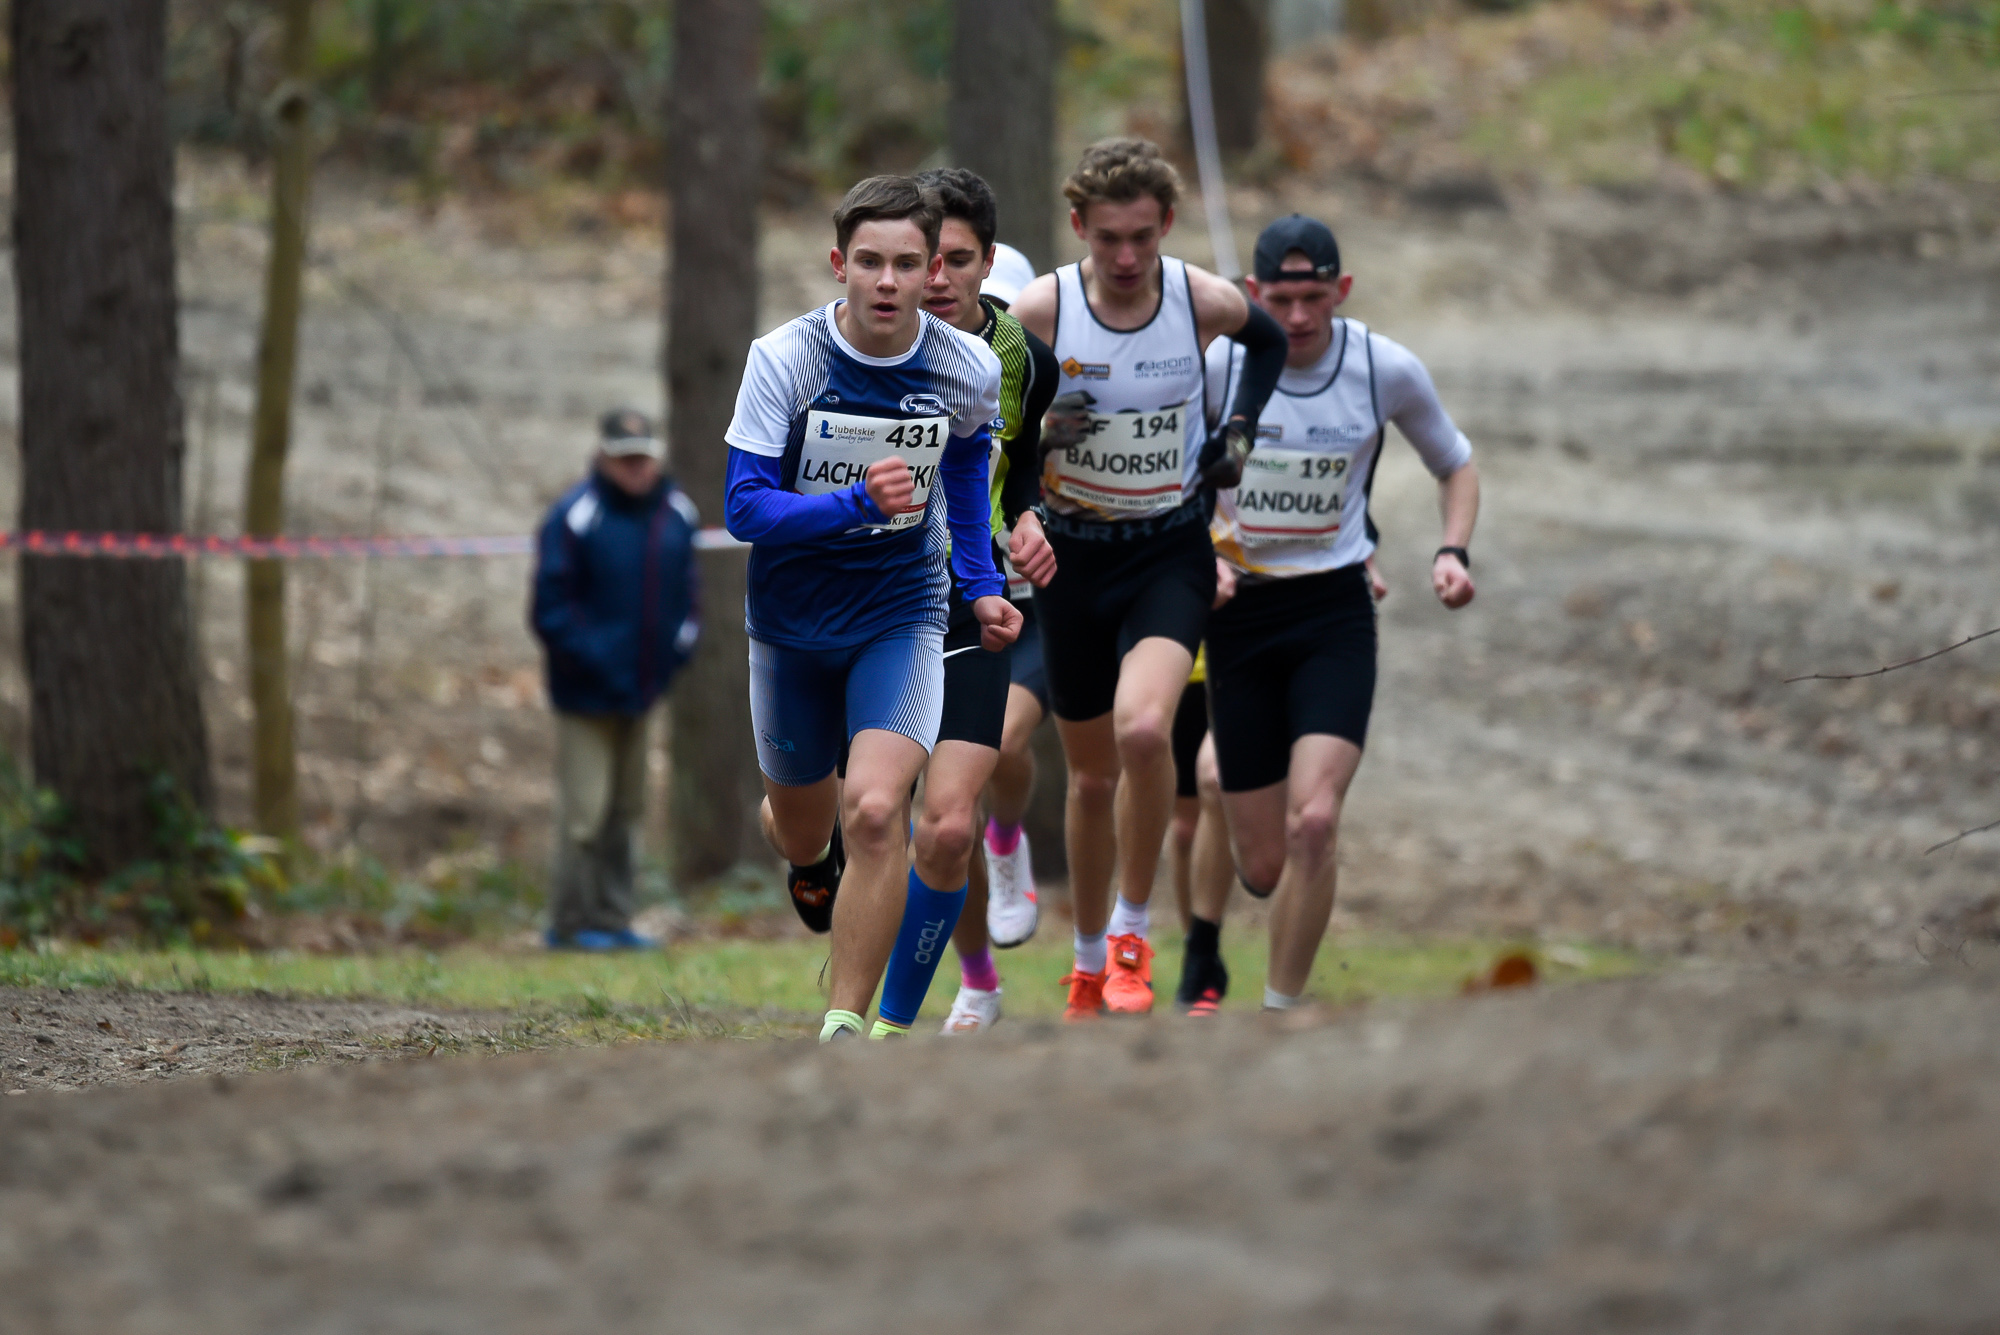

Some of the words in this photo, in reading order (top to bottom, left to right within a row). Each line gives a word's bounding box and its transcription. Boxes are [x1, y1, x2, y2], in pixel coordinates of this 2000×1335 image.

[834, 424, 876, 437] lubelskie
[885, 423, 940, 449] 431
[1132, 412, 1178, 439] 194
[1065, 447, 1178, 475] BAJORSKI
[1299, 457, 1347, 479] 199
[902, 513, 922, 526] 2021
